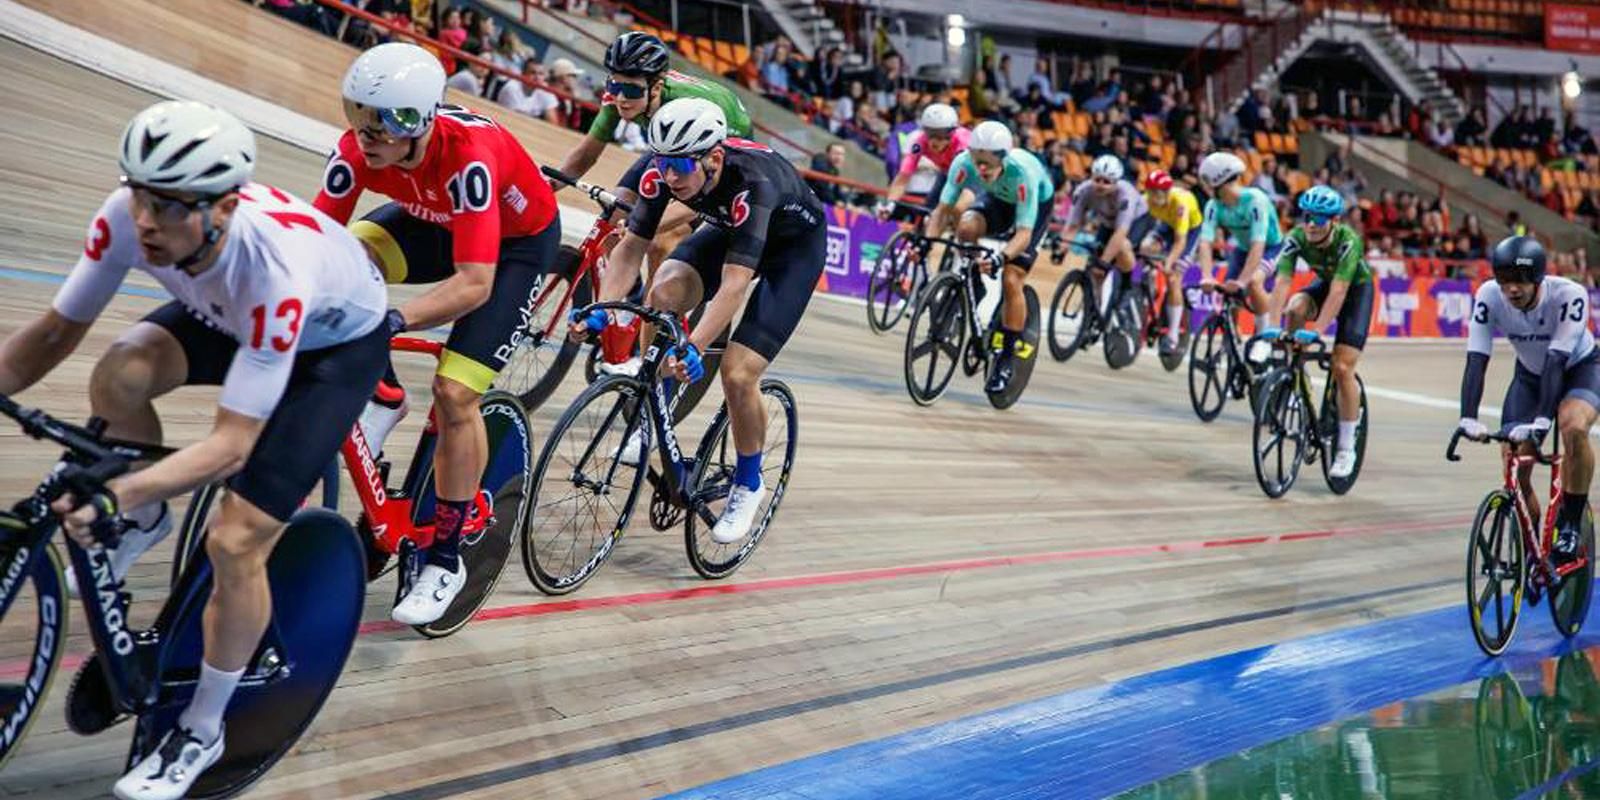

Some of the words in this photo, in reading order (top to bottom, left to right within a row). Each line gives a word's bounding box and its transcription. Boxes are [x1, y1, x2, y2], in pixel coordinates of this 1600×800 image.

[446, 161, 491, 214] 10
[731, 189, 750, 228] 6
[84, 217, 111, 261] 3
[249, 298, 301, 353] 13
[1474, 302, 1489, 324] 3
[1559, 297, 1585, 322] 13
